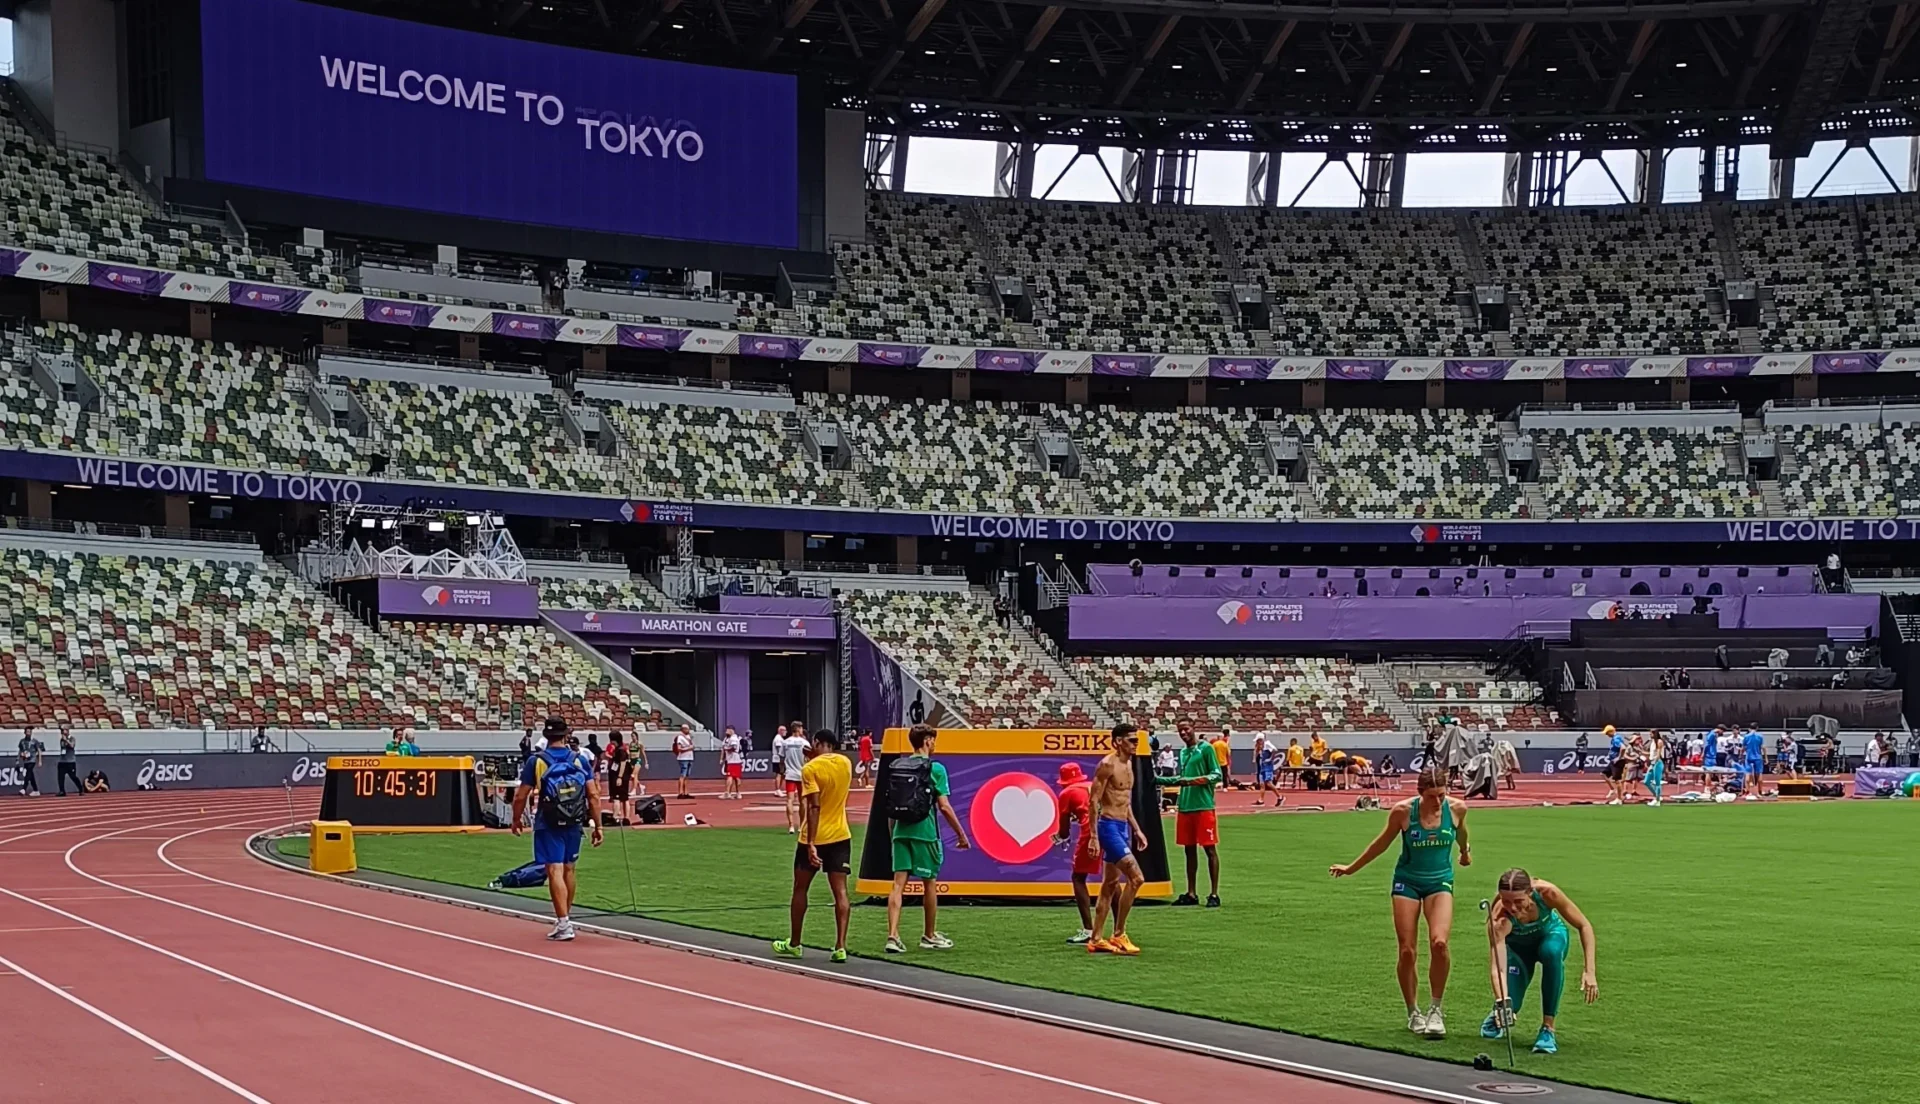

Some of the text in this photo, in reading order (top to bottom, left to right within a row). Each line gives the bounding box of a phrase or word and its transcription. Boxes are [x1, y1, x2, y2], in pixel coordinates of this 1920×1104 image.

[321, 55, 703, 162] WELCOME TO TOKYO
[76, 457, 361, 503] WELCOME TO TOKYO
[930, 515, 1174, 542] WELCOME TO TOKYO
[1726, 520, 1854, 542] WELCOME
[1863, 519, 1898, 540] TO
[641, 618, 748, 633] MARATHON GATE
[342, 758, 381, 767] SEIKO
[354, 771, 436, 796] 10:45:31
[1412, 839, 1450, 847] AUSTRALIA
[903, 883, 949, 893] SEO
